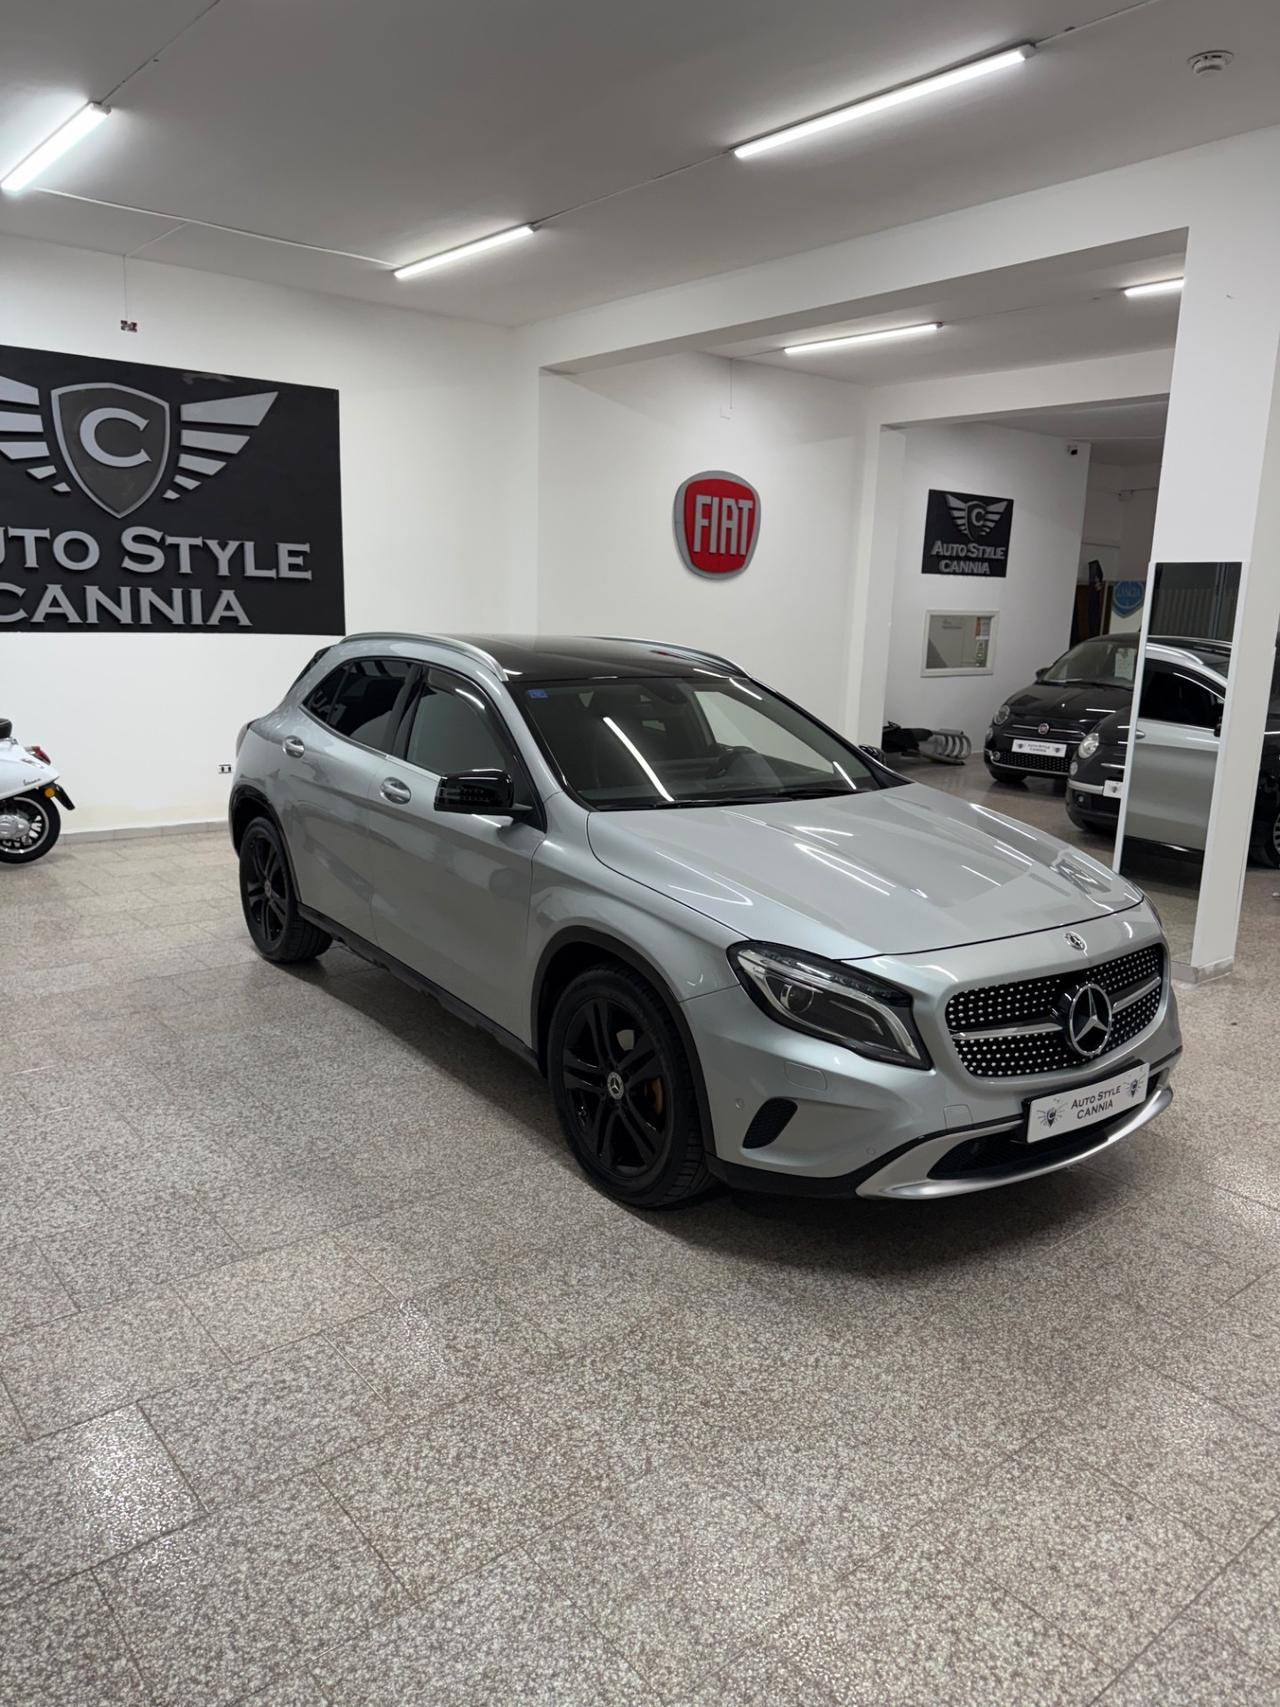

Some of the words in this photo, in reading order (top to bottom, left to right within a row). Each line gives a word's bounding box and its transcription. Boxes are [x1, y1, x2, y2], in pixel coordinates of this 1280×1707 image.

[79, 407, 152, 468] C
[694, 494, 753, 556] FIAT
[0, 526, 101, 571] TO
[120, 526, 312, 580] STYLE
[931, 540, 967, 557] AUTO
[967, 543, 1006, 560] STYLE
[939, 559, 990, 575] CANNIA
[1071, 1096, 1096, 1110] AUTO
[1097, 1085, 1121, 1101] STYLE
[1077, 1100, 1113, 1119] CANNIA
